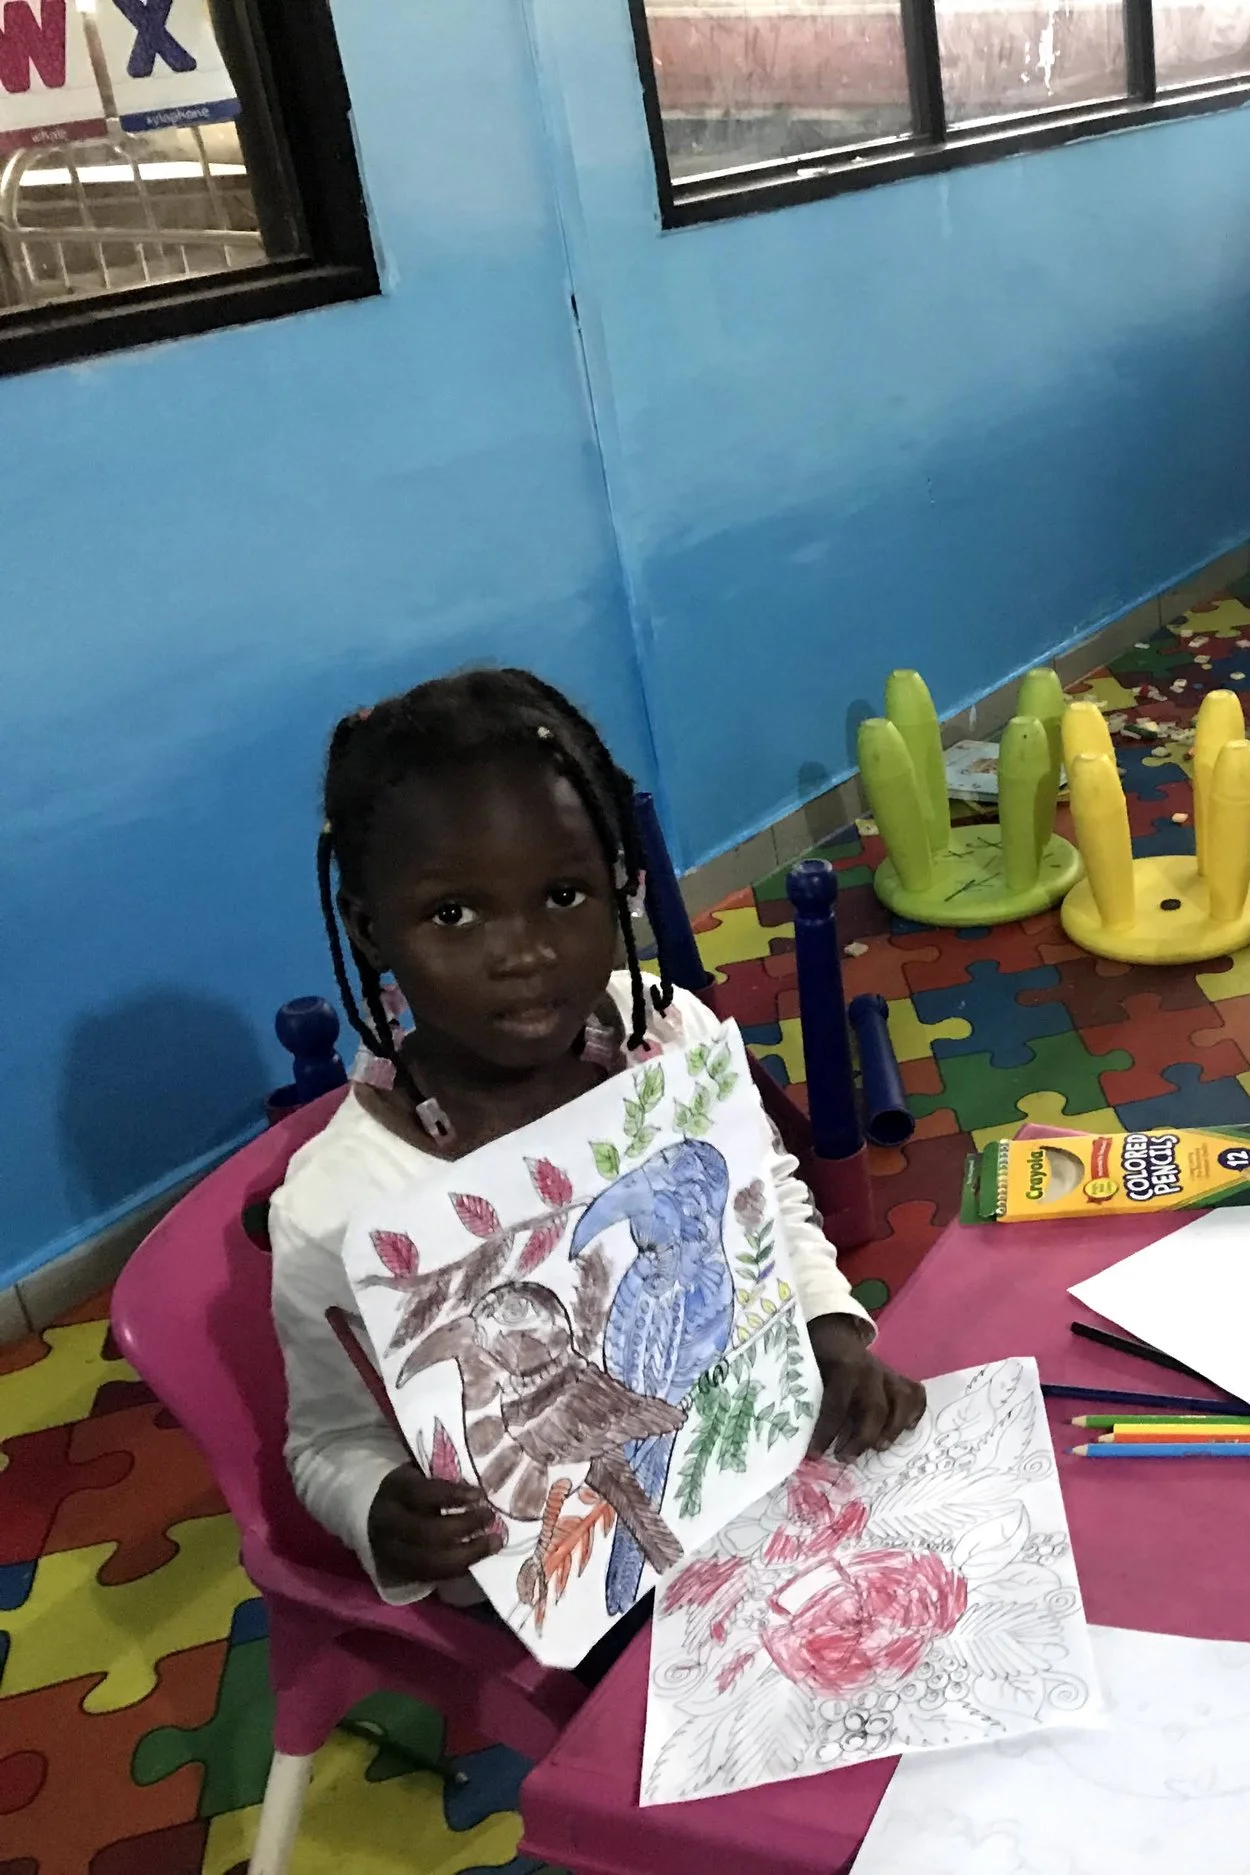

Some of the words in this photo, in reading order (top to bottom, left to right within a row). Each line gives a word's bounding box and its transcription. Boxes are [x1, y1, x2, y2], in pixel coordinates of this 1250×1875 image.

[0, 0, 66, 93] W
[112, 0, 197, 78] X
[1025, 1150, 1048, 1200] Crayola
[1123, 1133, 1154, 1201] COLORED
[1149, 1134, 1181, 1196] PENCILS
[1226, 1150, 1250, 1167] 12
